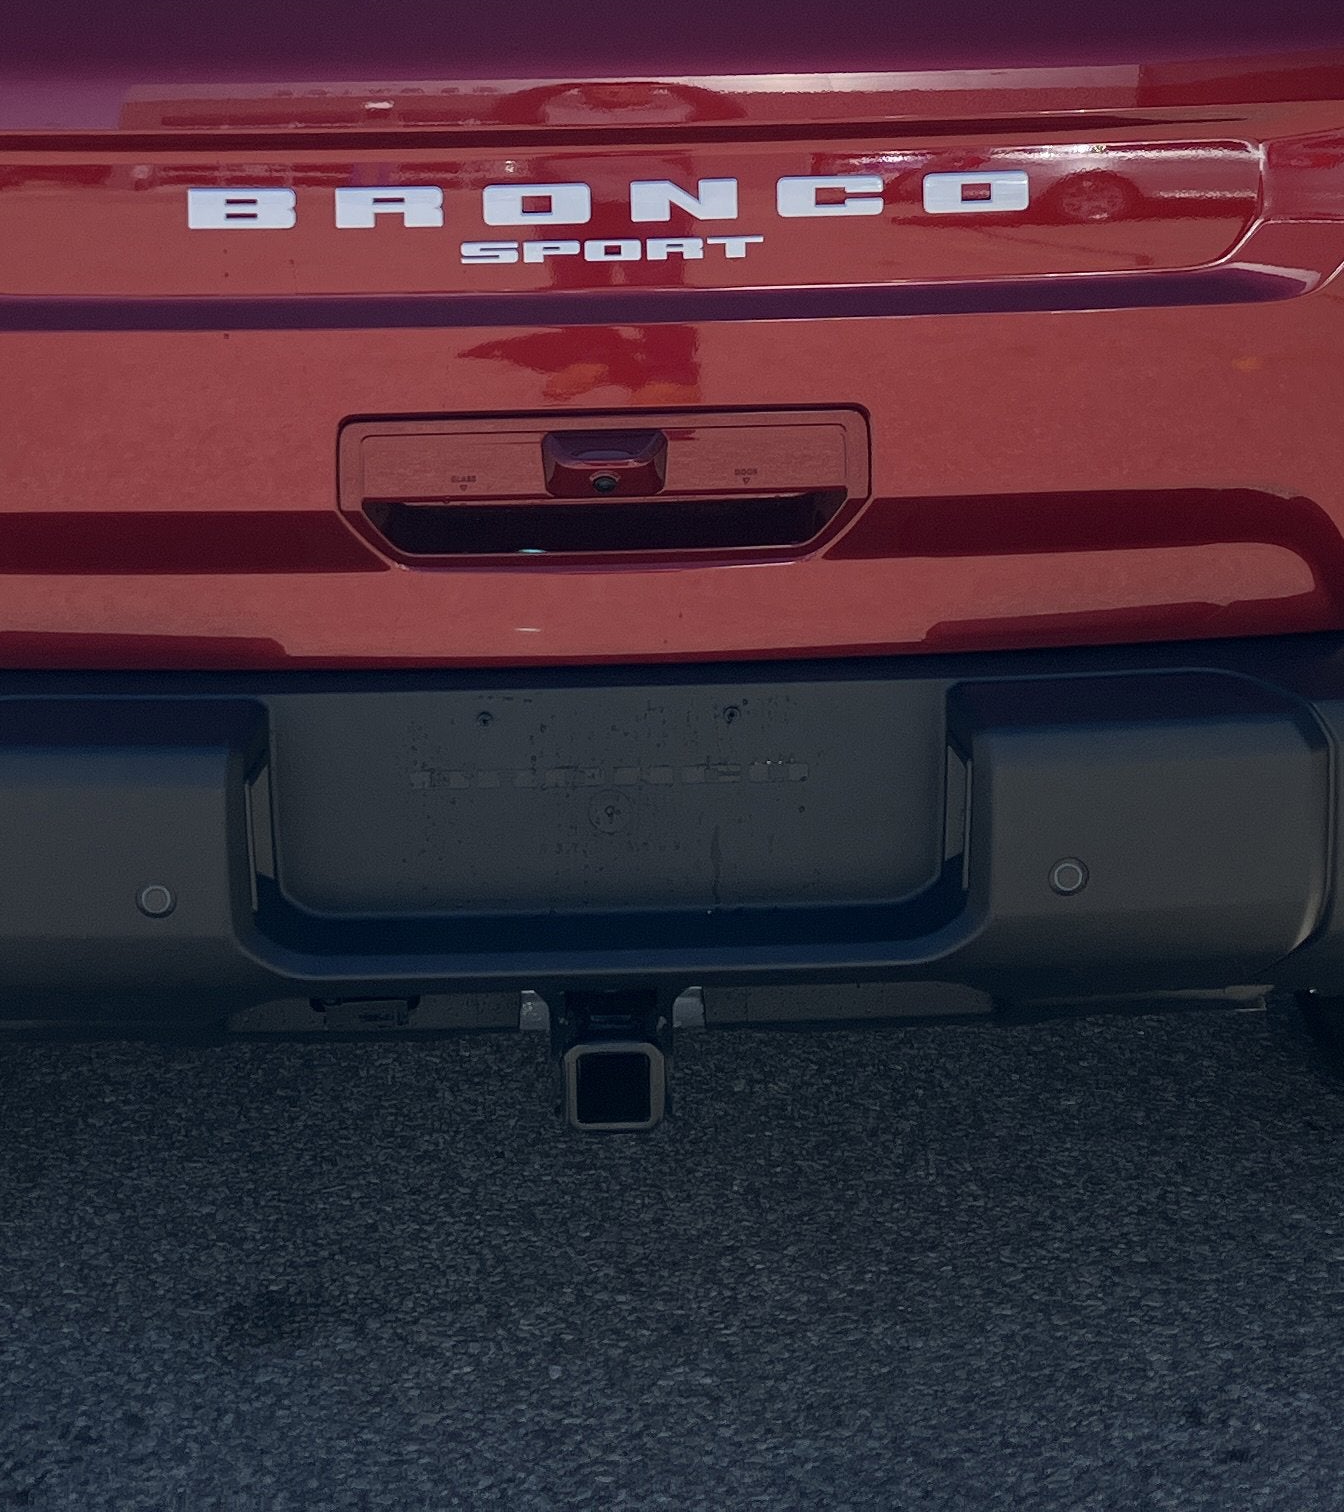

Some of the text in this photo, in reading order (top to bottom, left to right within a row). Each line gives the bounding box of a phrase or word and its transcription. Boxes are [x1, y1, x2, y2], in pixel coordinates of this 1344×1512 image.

[186, 171, 1030, 231] BRONCO
[459, 235, 764, 265] SPORT
[734, 467, 758, 476] DOOR
